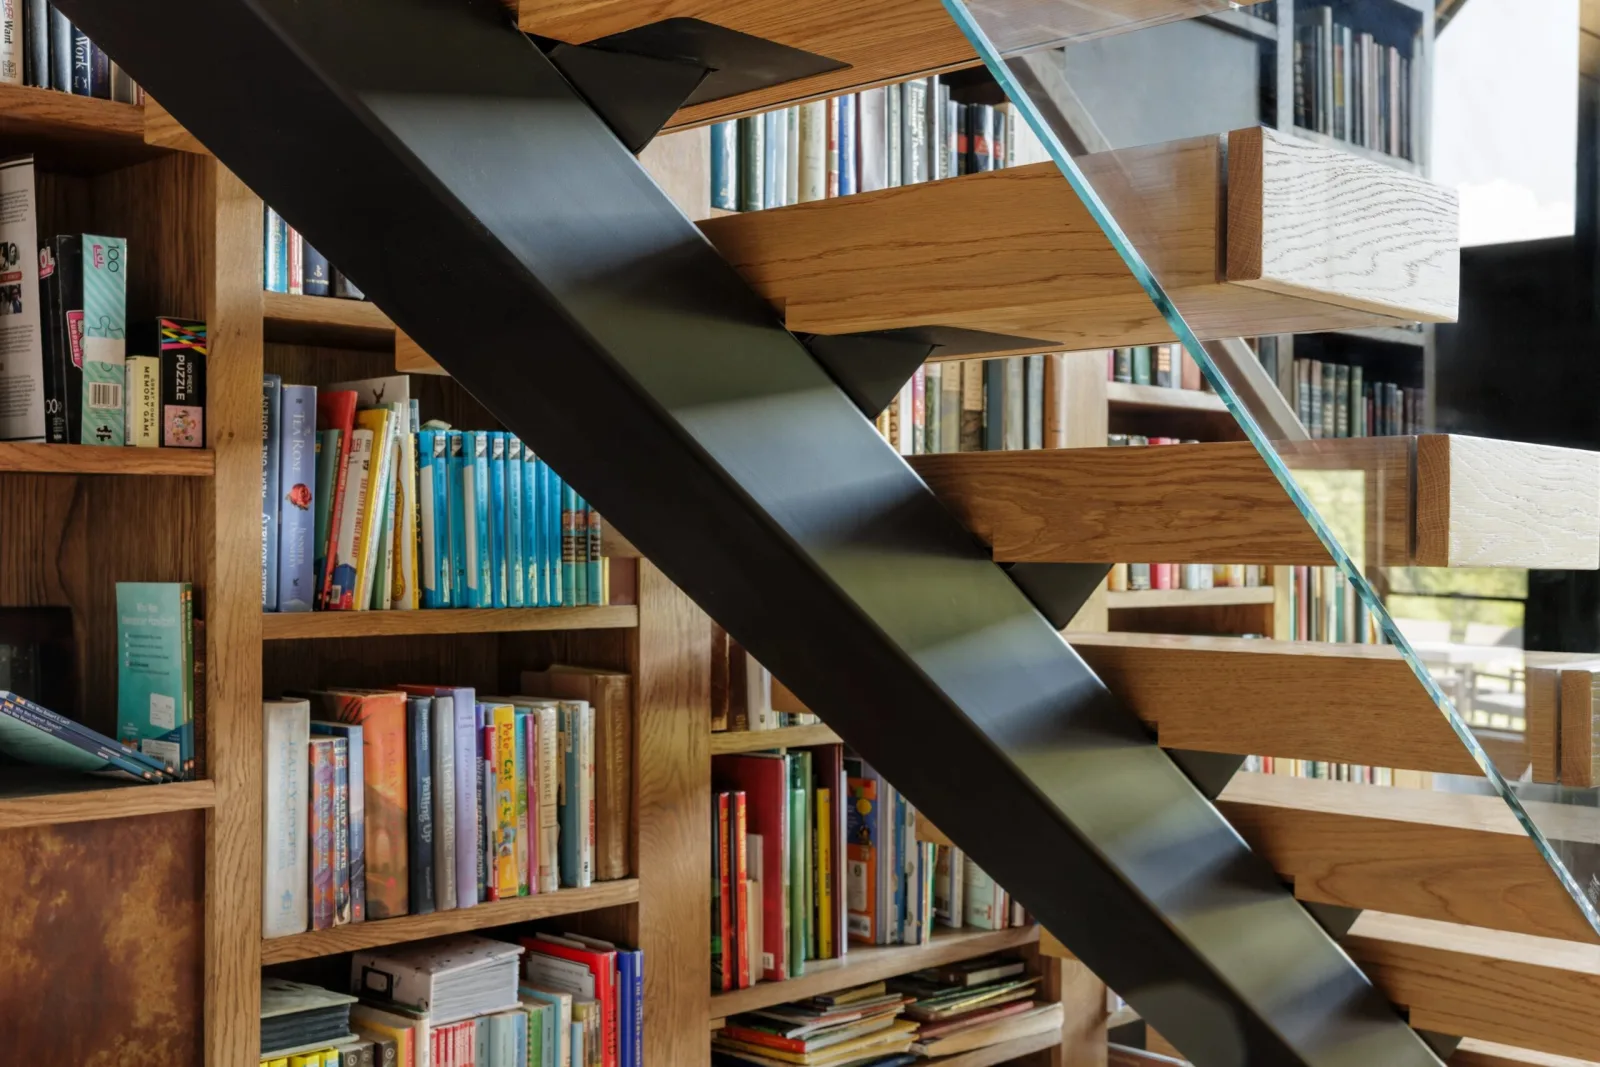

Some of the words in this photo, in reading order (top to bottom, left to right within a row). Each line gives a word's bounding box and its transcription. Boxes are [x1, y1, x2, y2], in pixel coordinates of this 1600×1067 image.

[4, 20, 13, 44] Want
[75, 36, 89, 69] Work
[107, 245, 119, 273] 100
[176, 354, 186, 401] PUZZLE
[292, 411, 306, 436] TEA
[292, 438, 305, 475] ROSE
[298, 526, 307, 565] JENNIFER
[502, 723, 513, 750] Pete
[543, 718, 551, 734] ON
[543, 737, 551, 755] THE
[288, 741, 298, 799] HARRY
[476, 756, 484, 786] WHERE
[503, 759, 514, 781] Cat
[543, 759, 552, 800] PRAIRIE
[321, 783, 329, 825] HARRY
[419, 775, 431, 823] Falling
[288, 806, 298, 867] POTTER
[421, 823, 432, 843] Up
[321, 828, 329, 870] POTTER
[476, 848, 484, 878] GROWS
